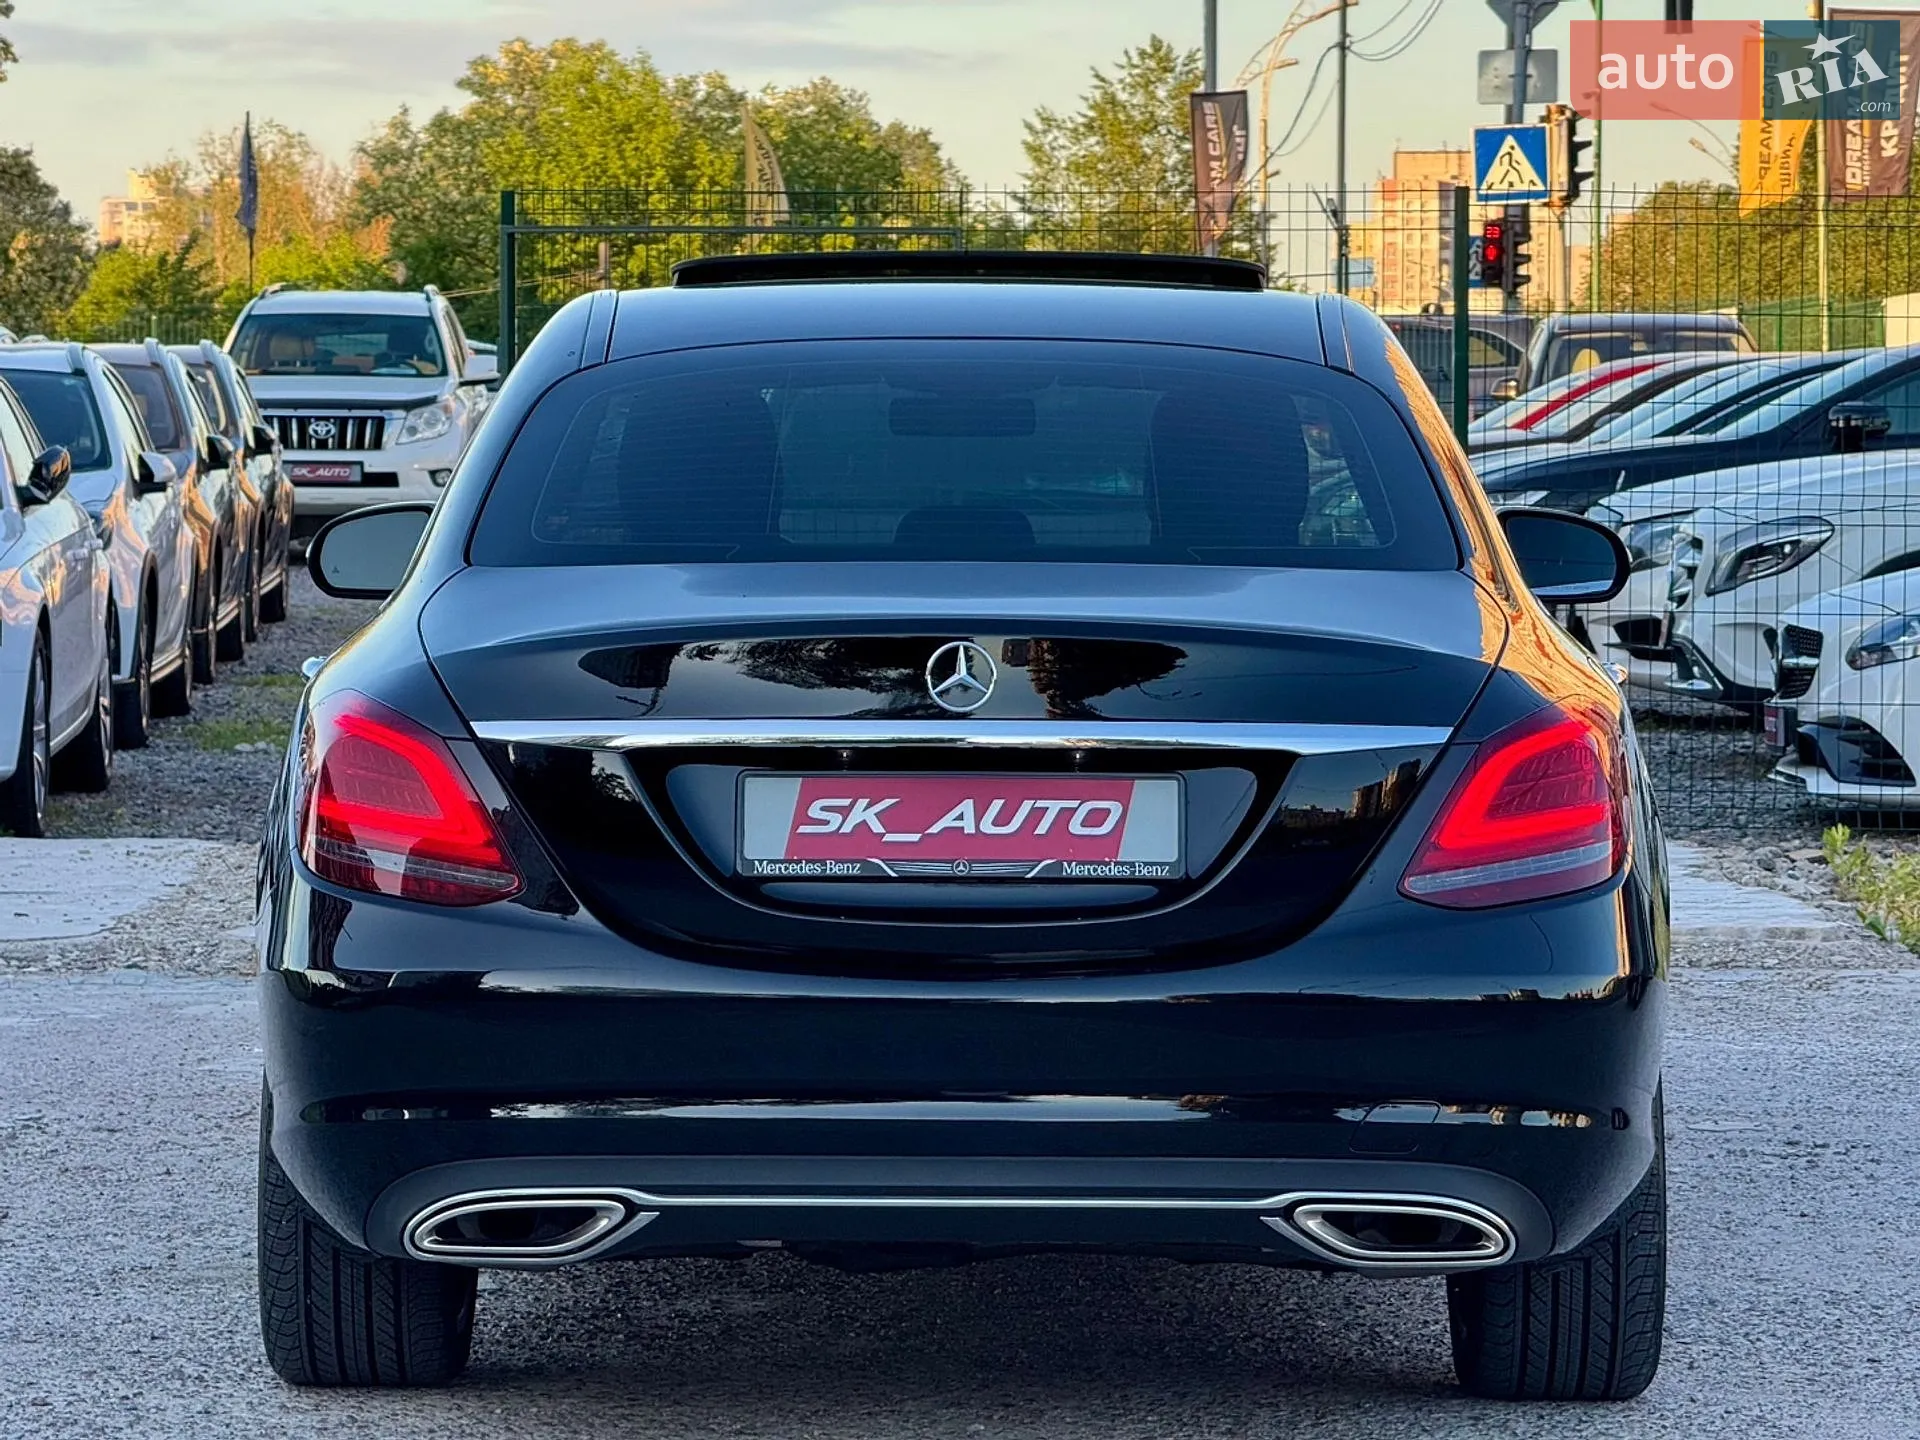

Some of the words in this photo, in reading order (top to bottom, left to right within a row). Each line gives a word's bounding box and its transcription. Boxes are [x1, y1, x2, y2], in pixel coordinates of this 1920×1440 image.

[796, 798, 1124, 842] SK_AUTO
[753, 858, 861, 877] Mercedes-Benz
[1061, 860, 1170, 877] Mercedes-Benz
